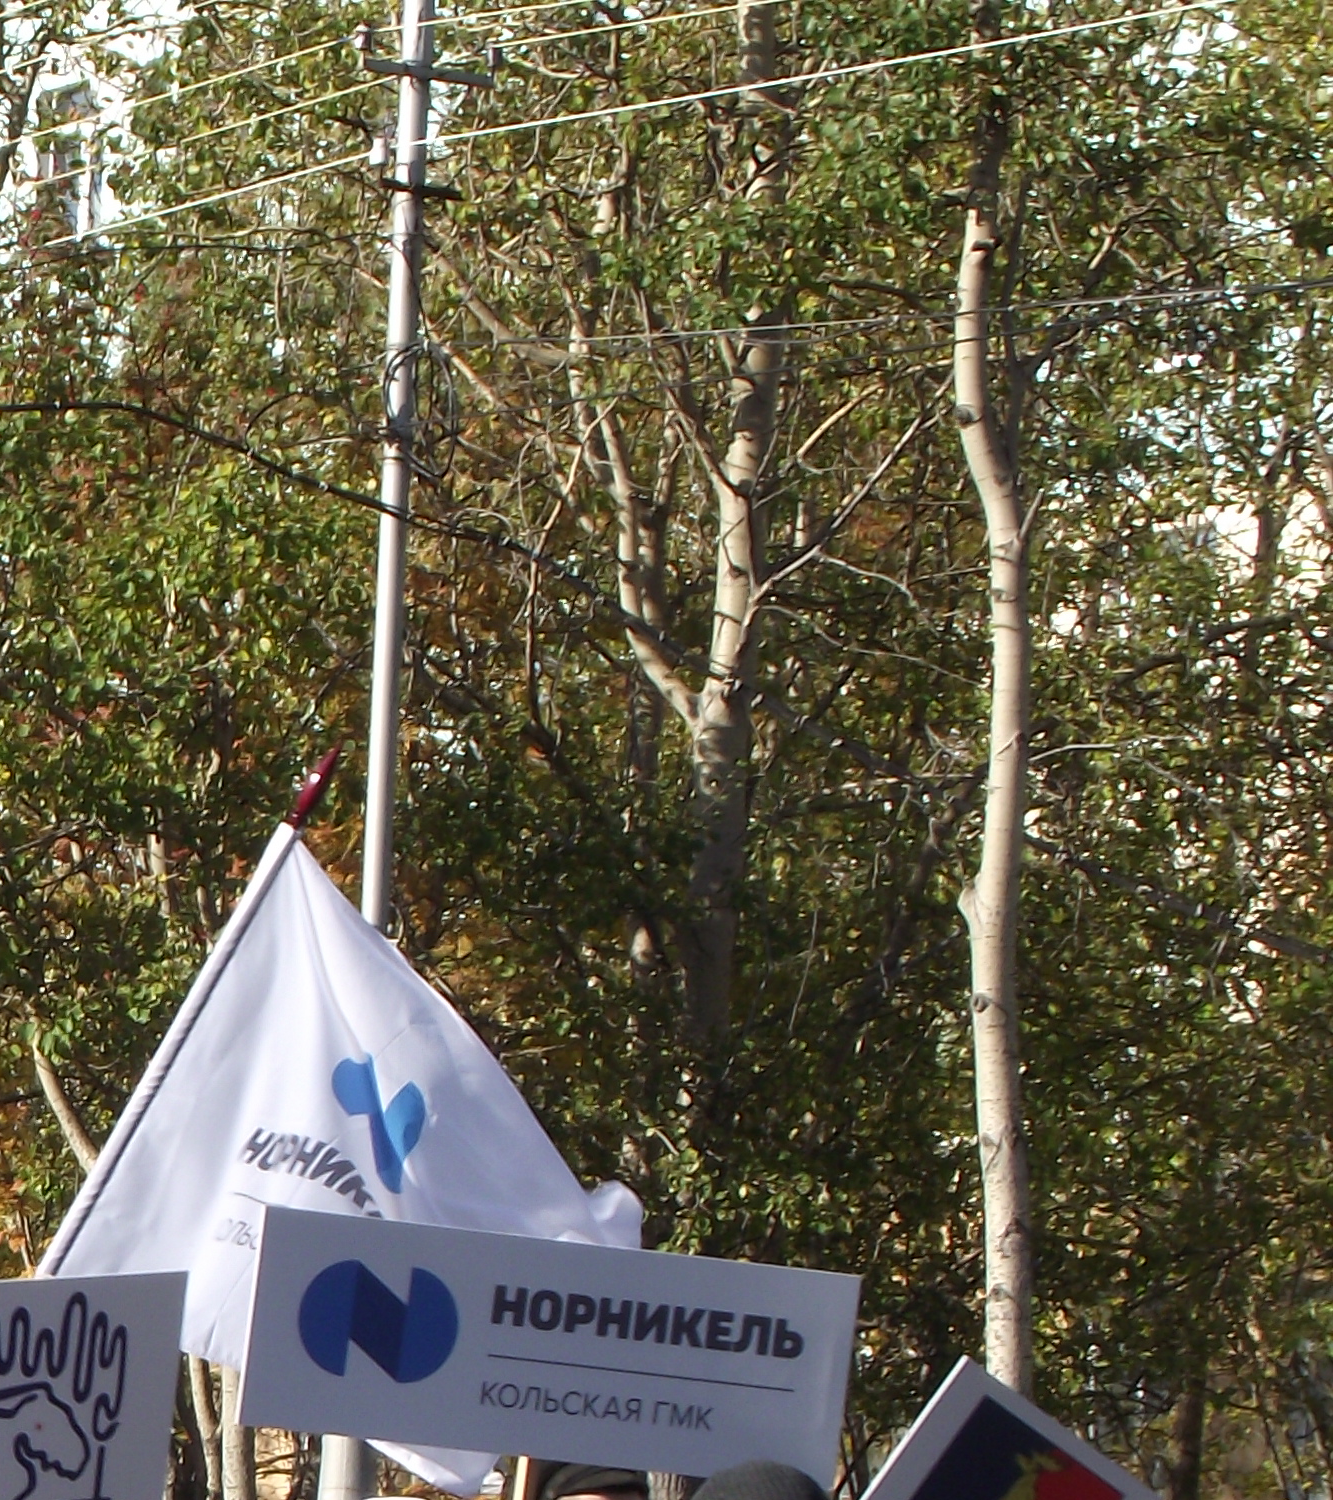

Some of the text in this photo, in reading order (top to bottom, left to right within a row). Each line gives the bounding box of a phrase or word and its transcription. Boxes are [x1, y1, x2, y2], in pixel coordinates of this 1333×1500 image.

[492, 1284, 805, 1361] НОРНИКЕЛЬ
[479, 1381, 713, 1432] КОЛЬСКАЯ ГМК
